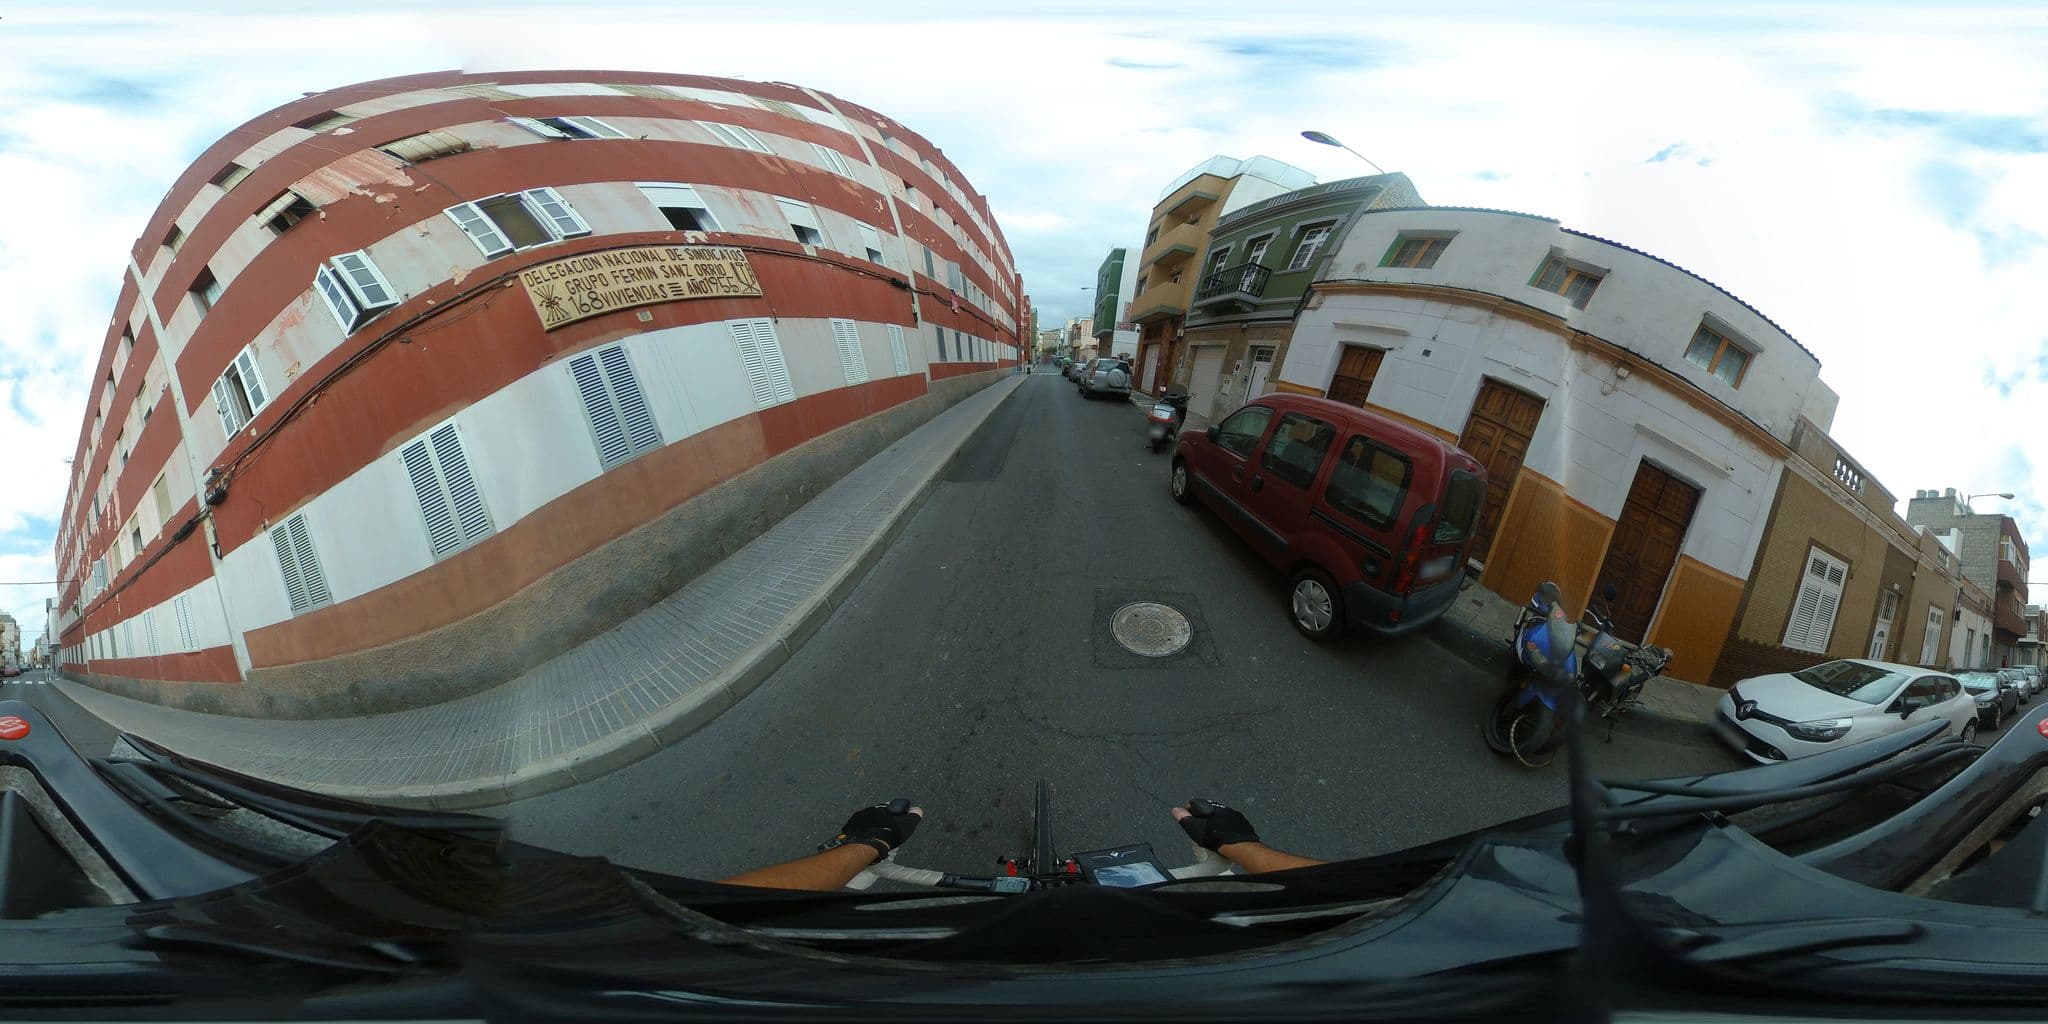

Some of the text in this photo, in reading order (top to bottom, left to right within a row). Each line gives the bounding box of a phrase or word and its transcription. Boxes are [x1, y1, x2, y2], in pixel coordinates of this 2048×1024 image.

[524, 247, 745, 287] DELEGACION NACIONAL DE SINDICATOS
[565, 263, 727, 295] GRUPO FERMIN SANZ ORRIO
[568, 276, 740, 314] 168 VIVIENDAS AÑO 1955
